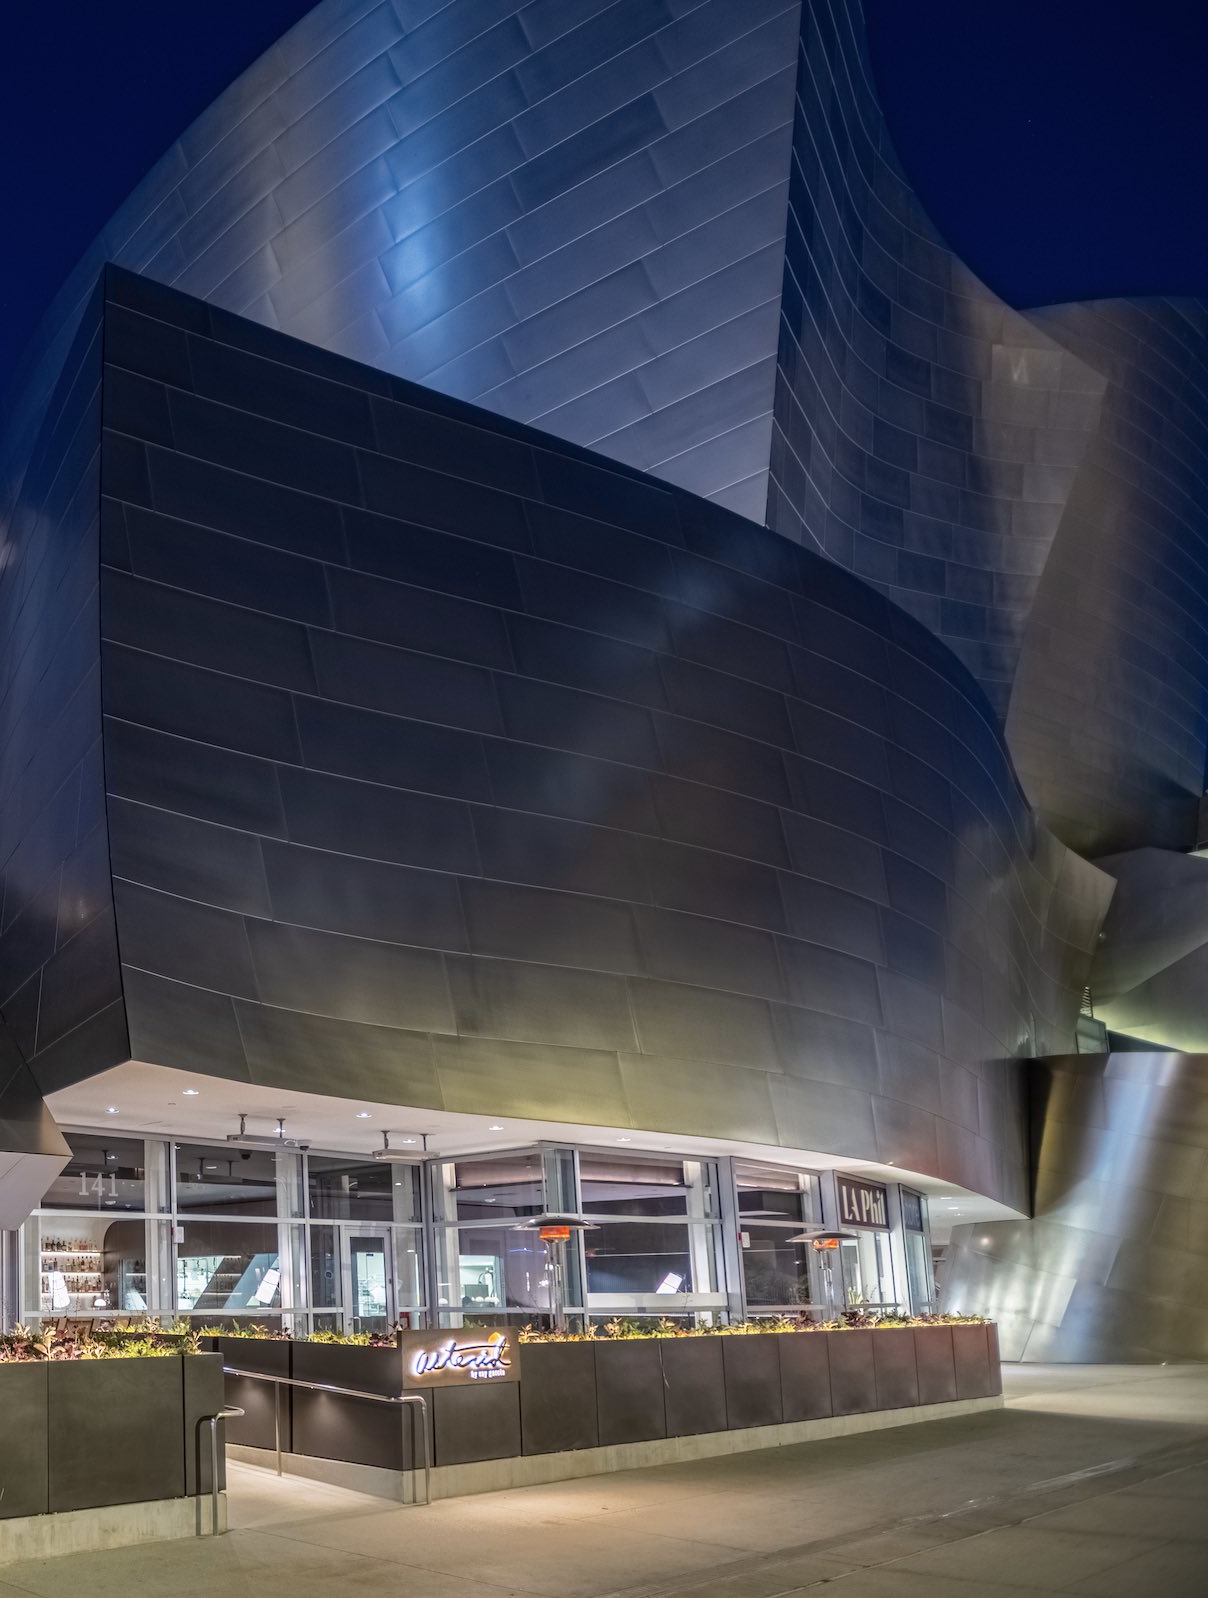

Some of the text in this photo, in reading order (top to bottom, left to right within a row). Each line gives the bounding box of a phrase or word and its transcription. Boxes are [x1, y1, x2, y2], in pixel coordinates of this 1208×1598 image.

[78, 1171, 119, 1197] 141
[841, 1185, 860, 1221] LA
[860, 1189, 886, 1225] Phil
